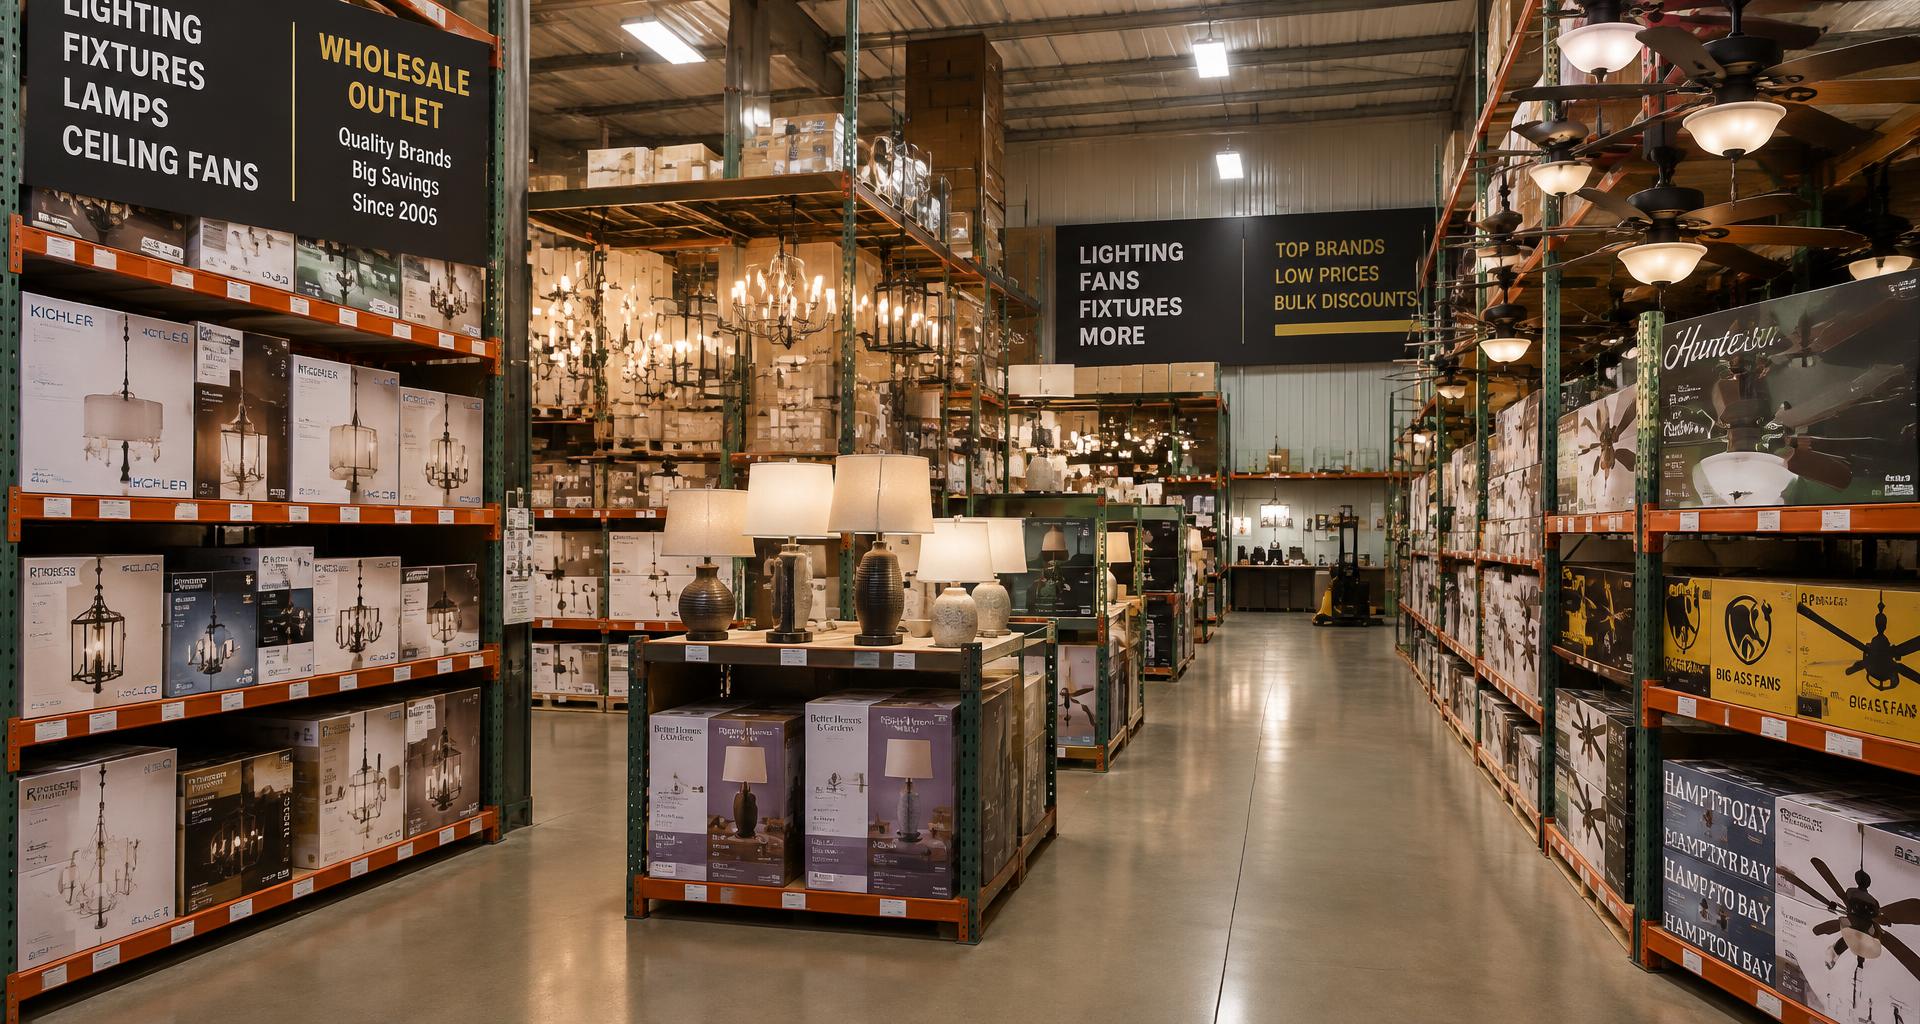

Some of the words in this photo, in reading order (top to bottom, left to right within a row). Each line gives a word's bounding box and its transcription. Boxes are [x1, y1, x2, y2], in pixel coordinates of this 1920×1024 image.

[64, 0, 202, 45] LIGHTING
[64, 31, 205, 91] FIXTURES
[319, 32, 470, 97] WHOLESALE
[64, 76, 169, 128] LAMPS
[348, 81, 444, 129] OUTLET
[62, 124, 178, 175] CEILING
[188, 150, 259, 191] FANS
[338, 126, 394, 160] Quality
[399, 139, 452, 169] Brands
[352, 159, 377, 187] Big
[381, 166, 440, 198] Savings
[352, 192, 394, 218] Since
[398, 200, 438, 226] 2005
[1080, 242, 1184, 265] LIGHTING
[1275, 241, 1310, 258] TOP
[1315, 238, 1385, 257] BRANDS
[1080, 270, 1140, 292] FANS
[1275, 267, 1314, 284] LOW
[1319, 265, 1379, 283] PRICES
[1080, 297, 1183, 319] FIXTURES
[1274, 293, 1317, 311] BULK
[1322, 290, 1418, 309] DISCOUNTS
[1080, 325, 1146, 347] MORE
[1716, 667, 1731, 682] BIG
[1734, 671, 1752, 686] ASS
[1754, 674, 1781, 691] FANS
[1738, 893, 1772, 926] BAY
[1664, 911, 1740, 966] HAMPTON
[1743, 951, 1773, 983] BAY
